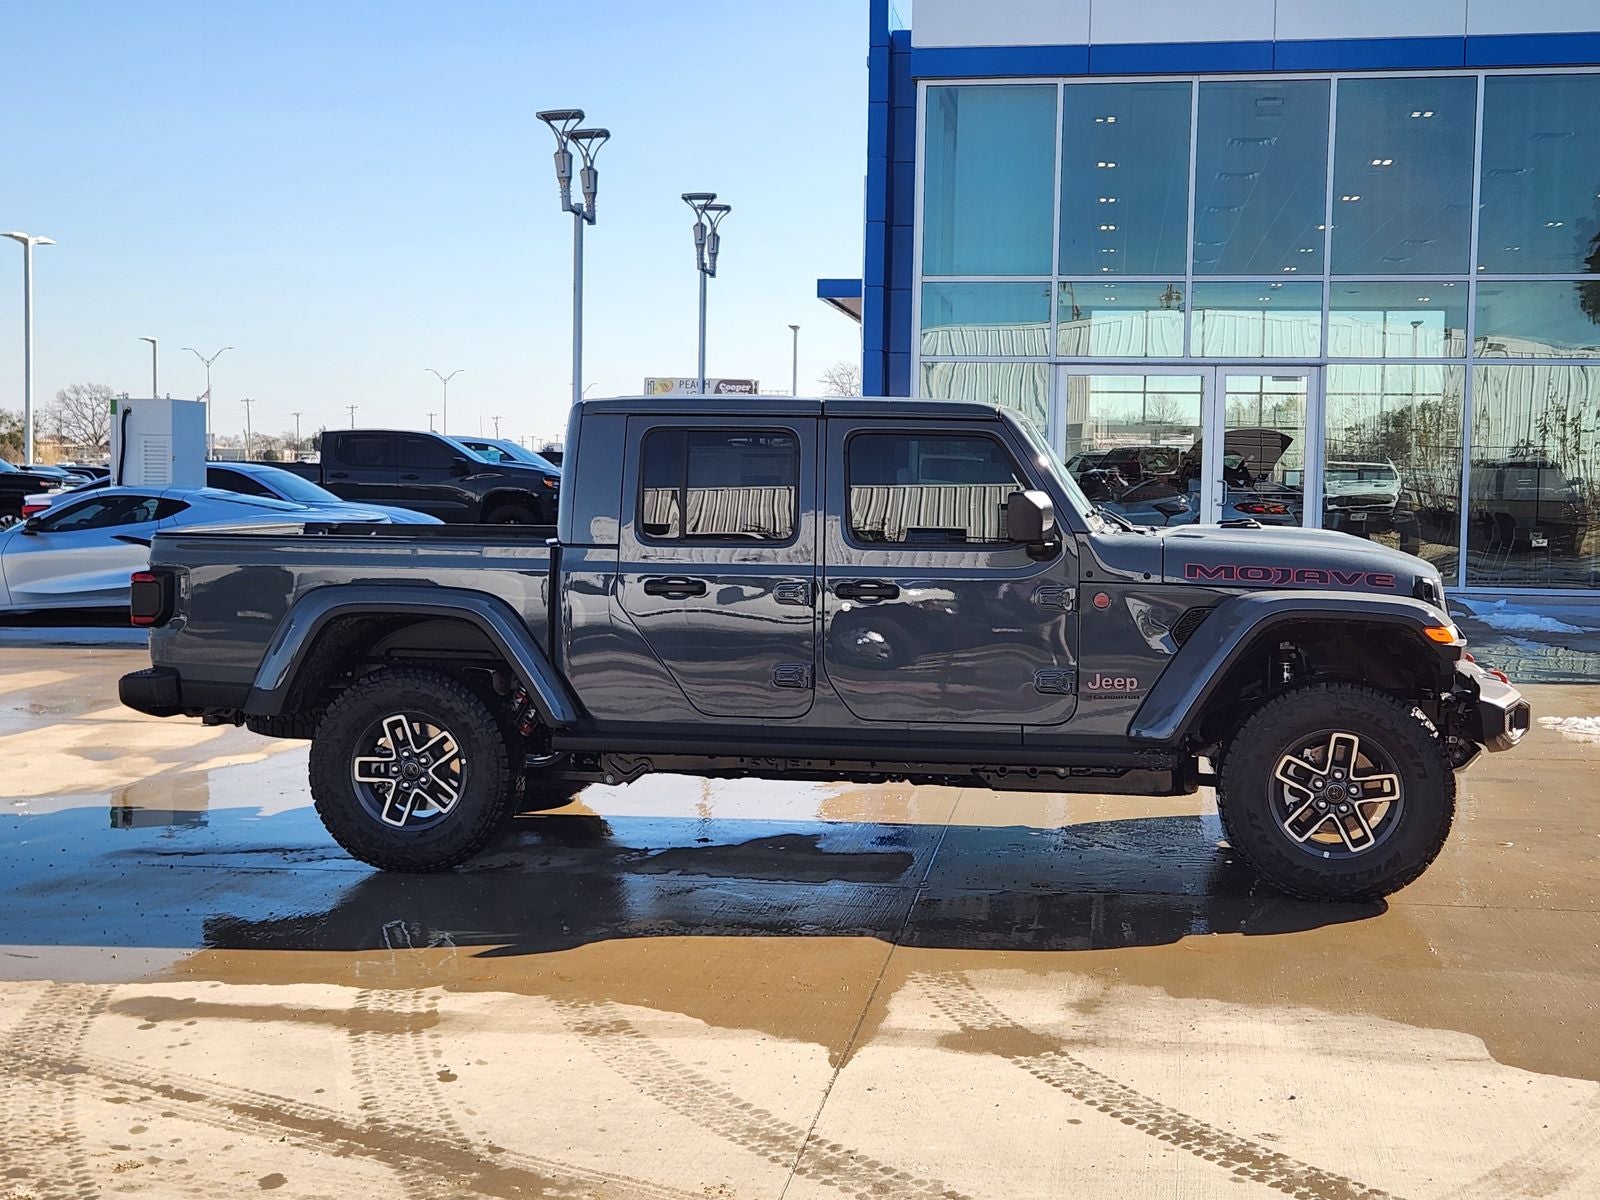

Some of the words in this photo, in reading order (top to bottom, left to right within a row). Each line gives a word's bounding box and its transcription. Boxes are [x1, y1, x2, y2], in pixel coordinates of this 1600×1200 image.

[719, 382, 752, 392] Cooper
[1184, 563, 1396, 588] MOJAVE
[1087, 673, 1138, 693] Jeep
